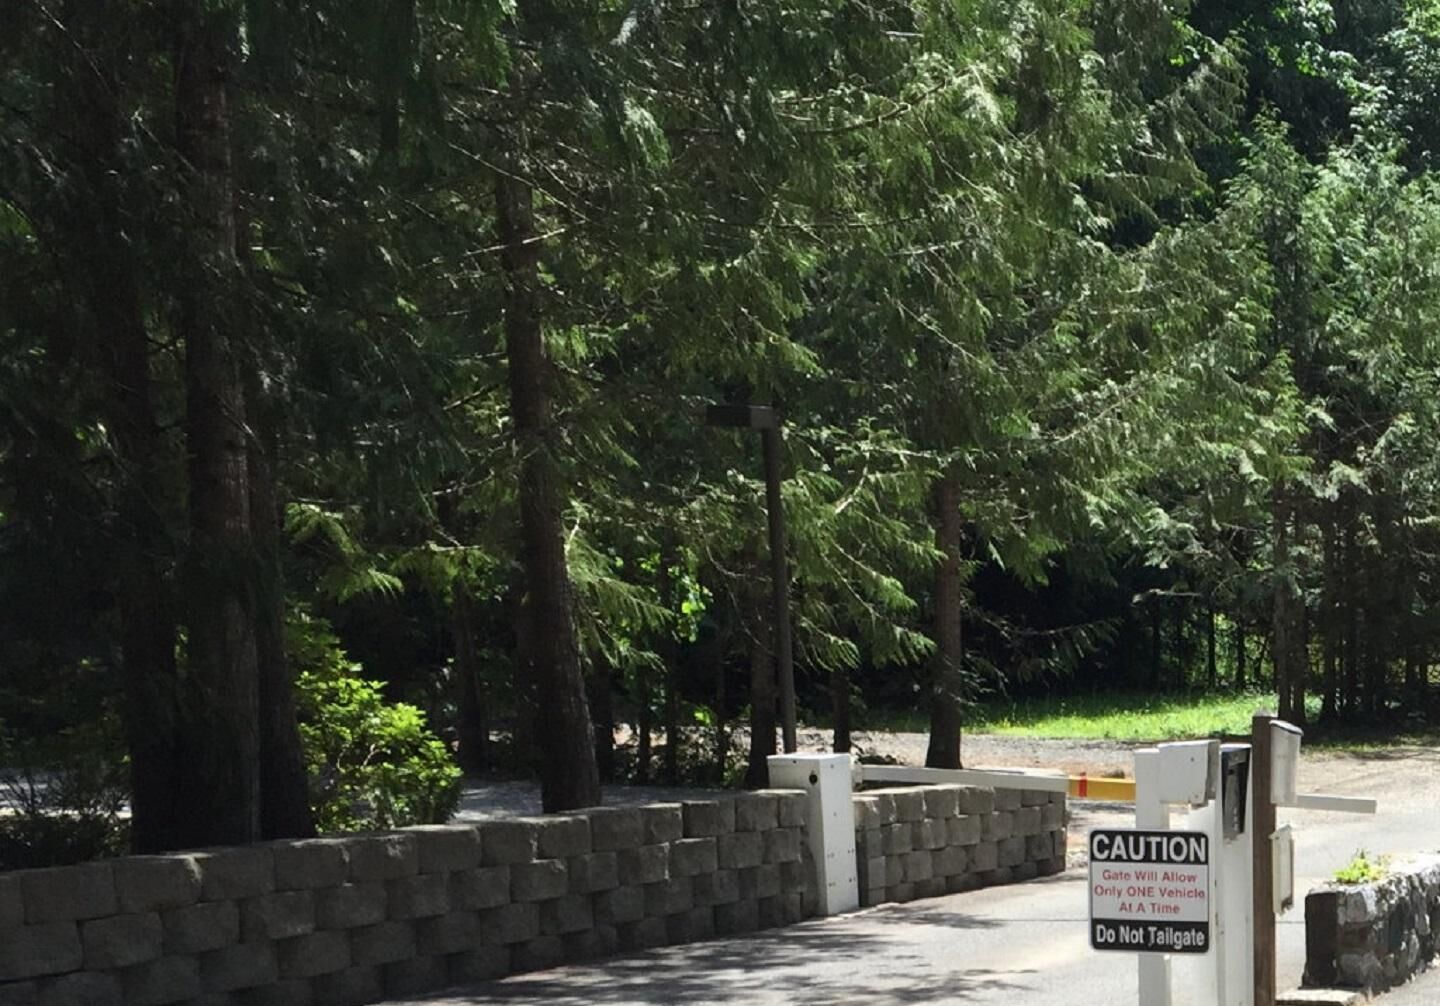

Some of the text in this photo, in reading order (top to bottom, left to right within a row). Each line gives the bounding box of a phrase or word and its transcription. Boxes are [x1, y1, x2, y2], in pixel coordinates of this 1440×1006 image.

[1092, 834, 1206, 862] CAUTION
[1102, 869, 1198, 883] Gate Will Allow
[1094, 884, 1206, 899] Only ONE Vehicle
[1119, 902, 1180, 914] At A Time
[1096, 924, 1205, 949] Do Not Tailgate
